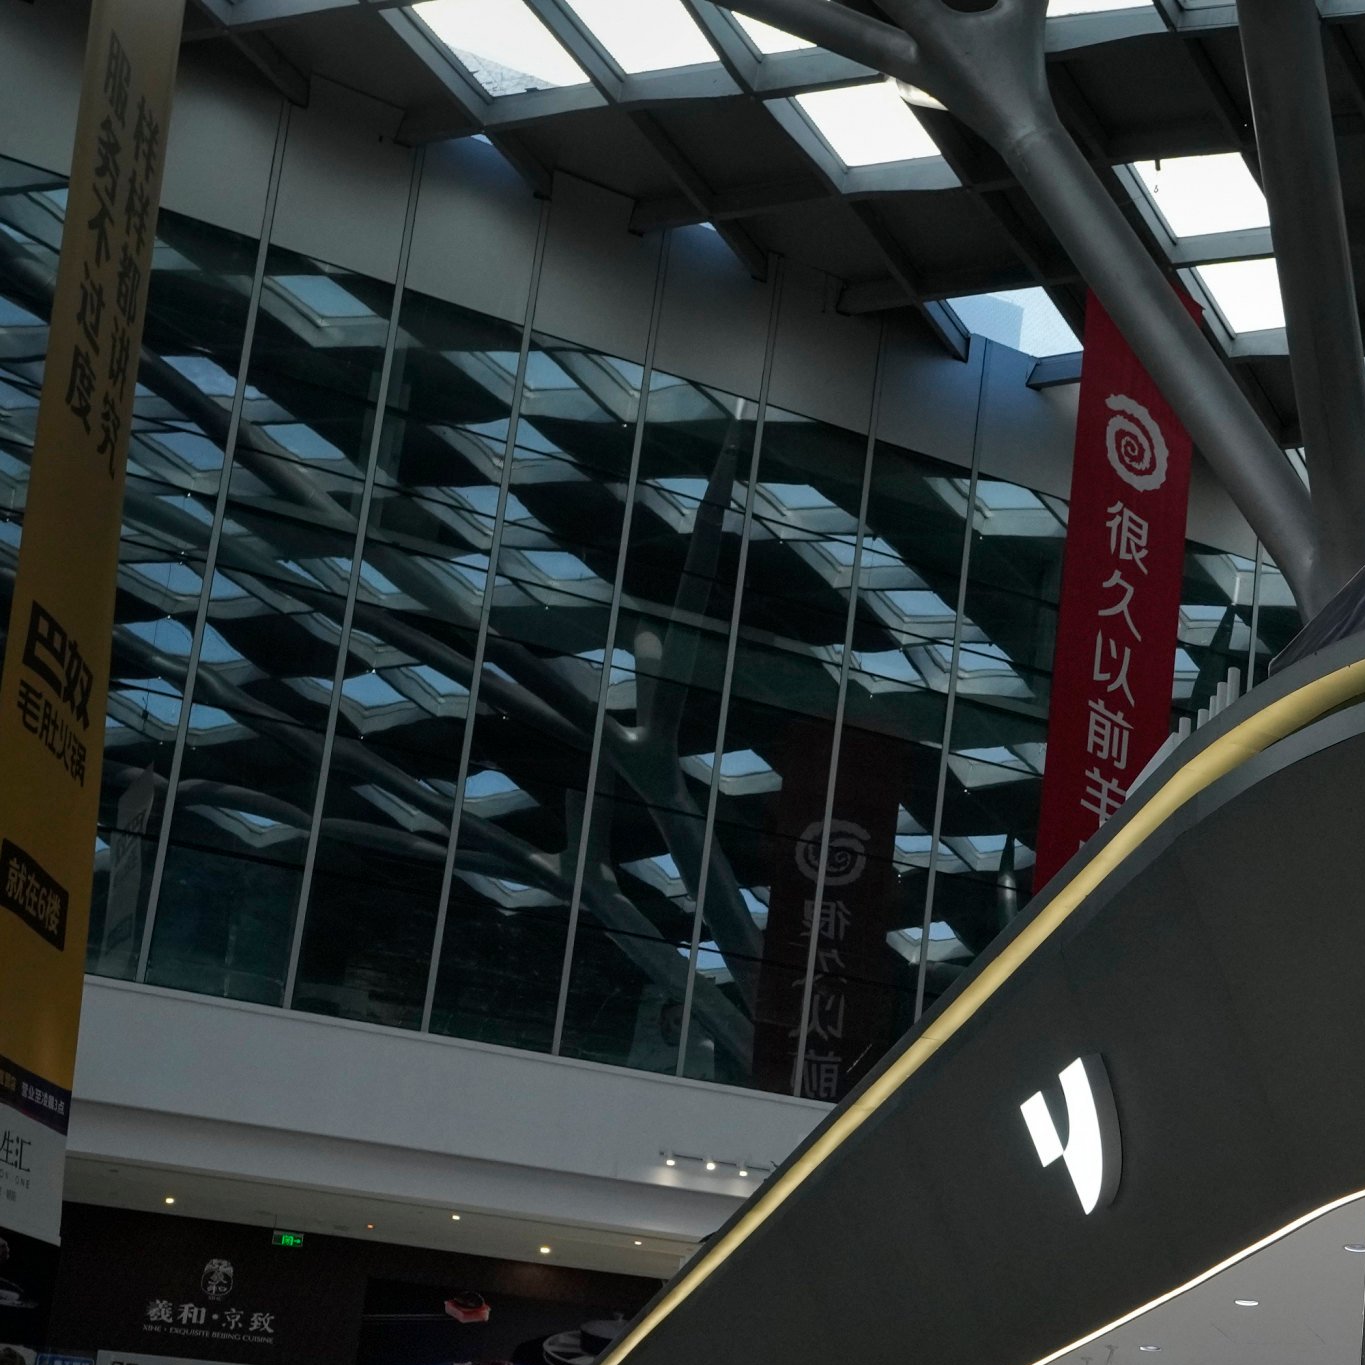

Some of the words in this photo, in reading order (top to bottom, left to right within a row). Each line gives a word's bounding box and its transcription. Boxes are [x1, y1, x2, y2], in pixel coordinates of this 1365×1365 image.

[22, 599, 94, 731] 巴奴
[1079, 499, 1149, 852] 很久以前羊
[17, 678, 87, 788] 毛肚火锅
[5, 856, 62, 937] 就在6楼
[169, 1326, 210, 1338] EXQUISITE
[211, 1330, 241, 1342] BEIJING
[242, 1334, 274, 1345] CUISINE
